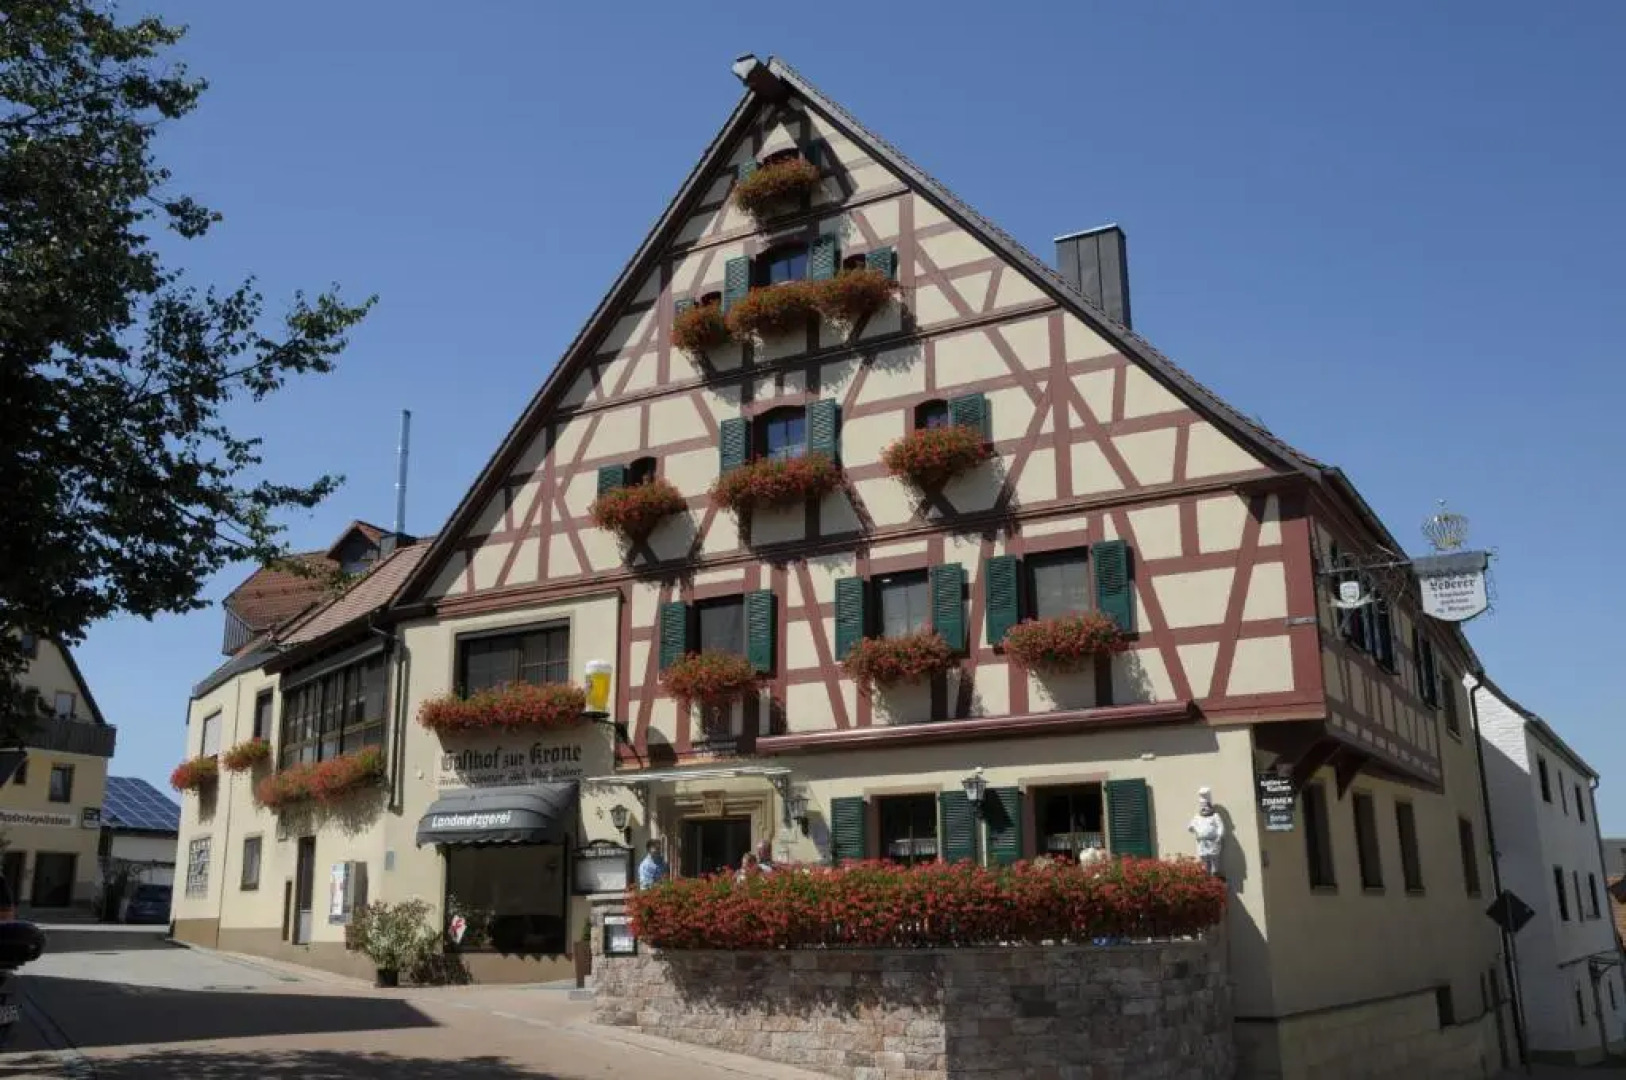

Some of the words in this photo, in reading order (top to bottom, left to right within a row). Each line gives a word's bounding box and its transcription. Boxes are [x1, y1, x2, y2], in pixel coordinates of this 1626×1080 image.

[441, 746, 502, 771] Gasthof
[502, 751, 525, 769] zur
[529, 742, 582, 765] Krone
[431, 810, 511, 829] Landmetzgerei
